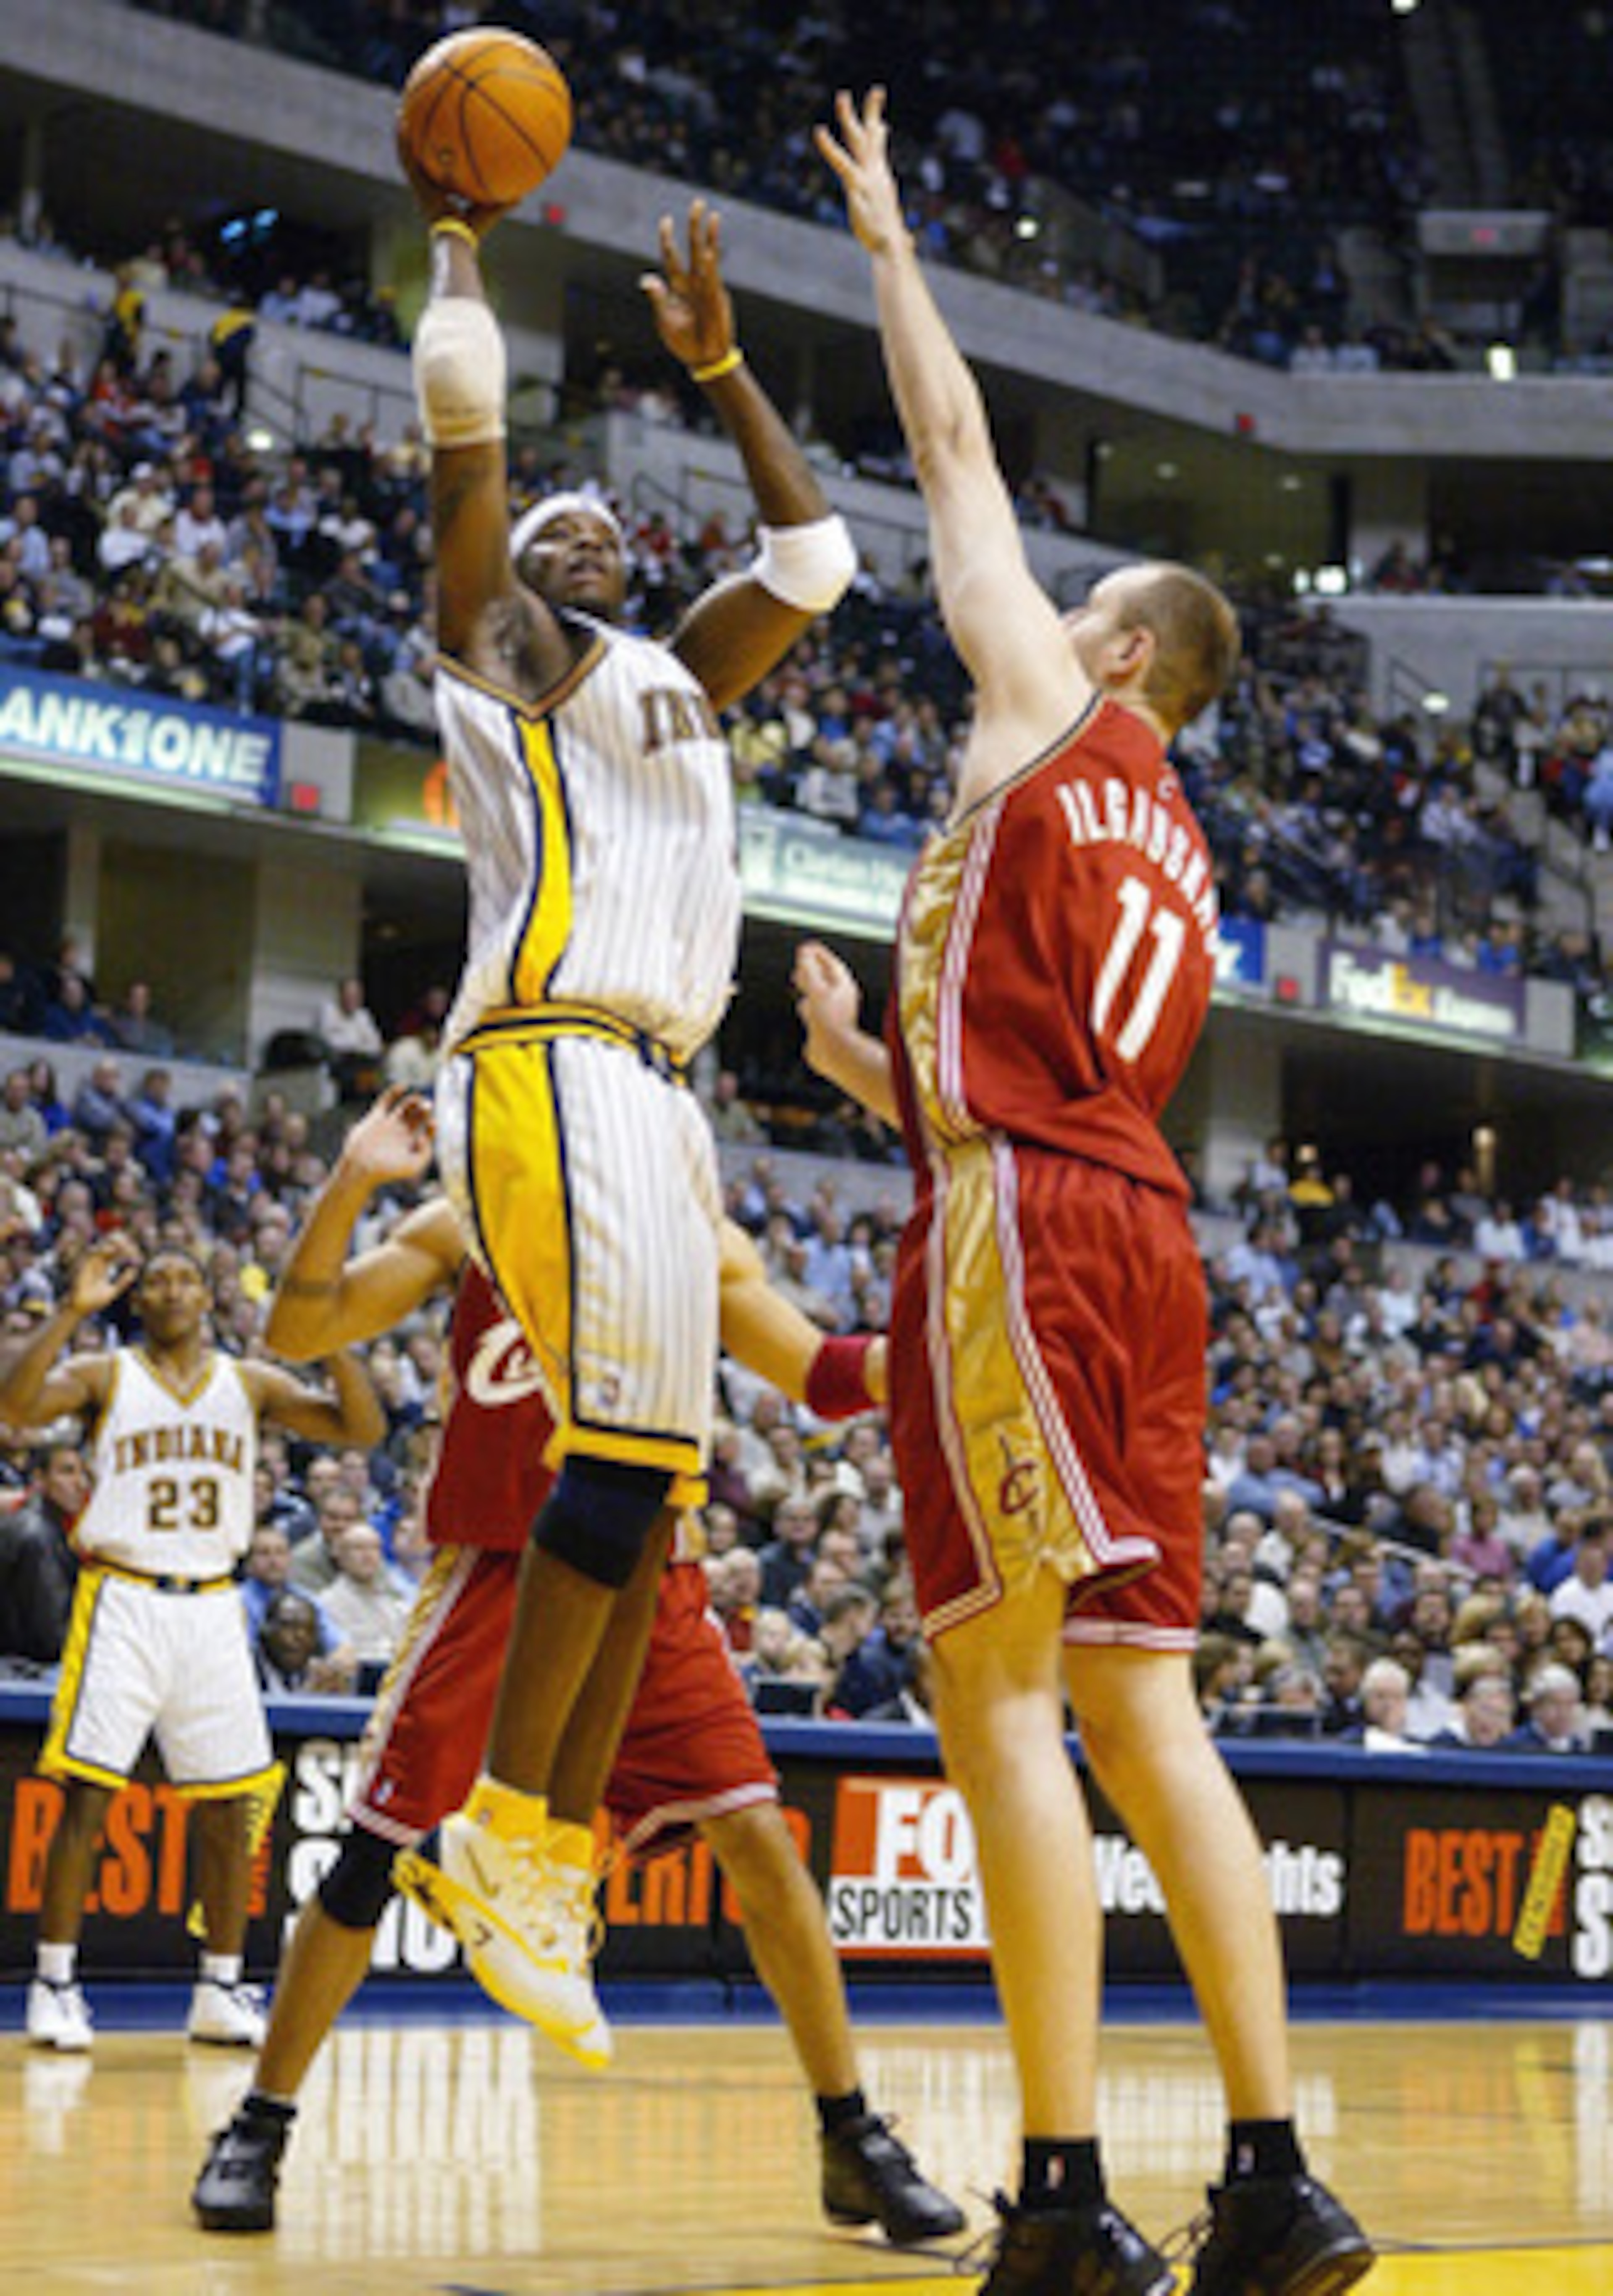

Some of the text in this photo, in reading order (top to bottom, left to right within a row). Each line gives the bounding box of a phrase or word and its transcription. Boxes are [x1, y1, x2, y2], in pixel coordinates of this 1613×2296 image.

[1093, 875, 1185, 1064] 11
[113, 1425, 244, 1474] INDIANA
[145, 1474, 219, 1532] 23
[874, 1786, 974, 1883] FO
[832, 1885, 975, 1941] SPORTS
[1402, 1827, 1526, 1938] BEST
